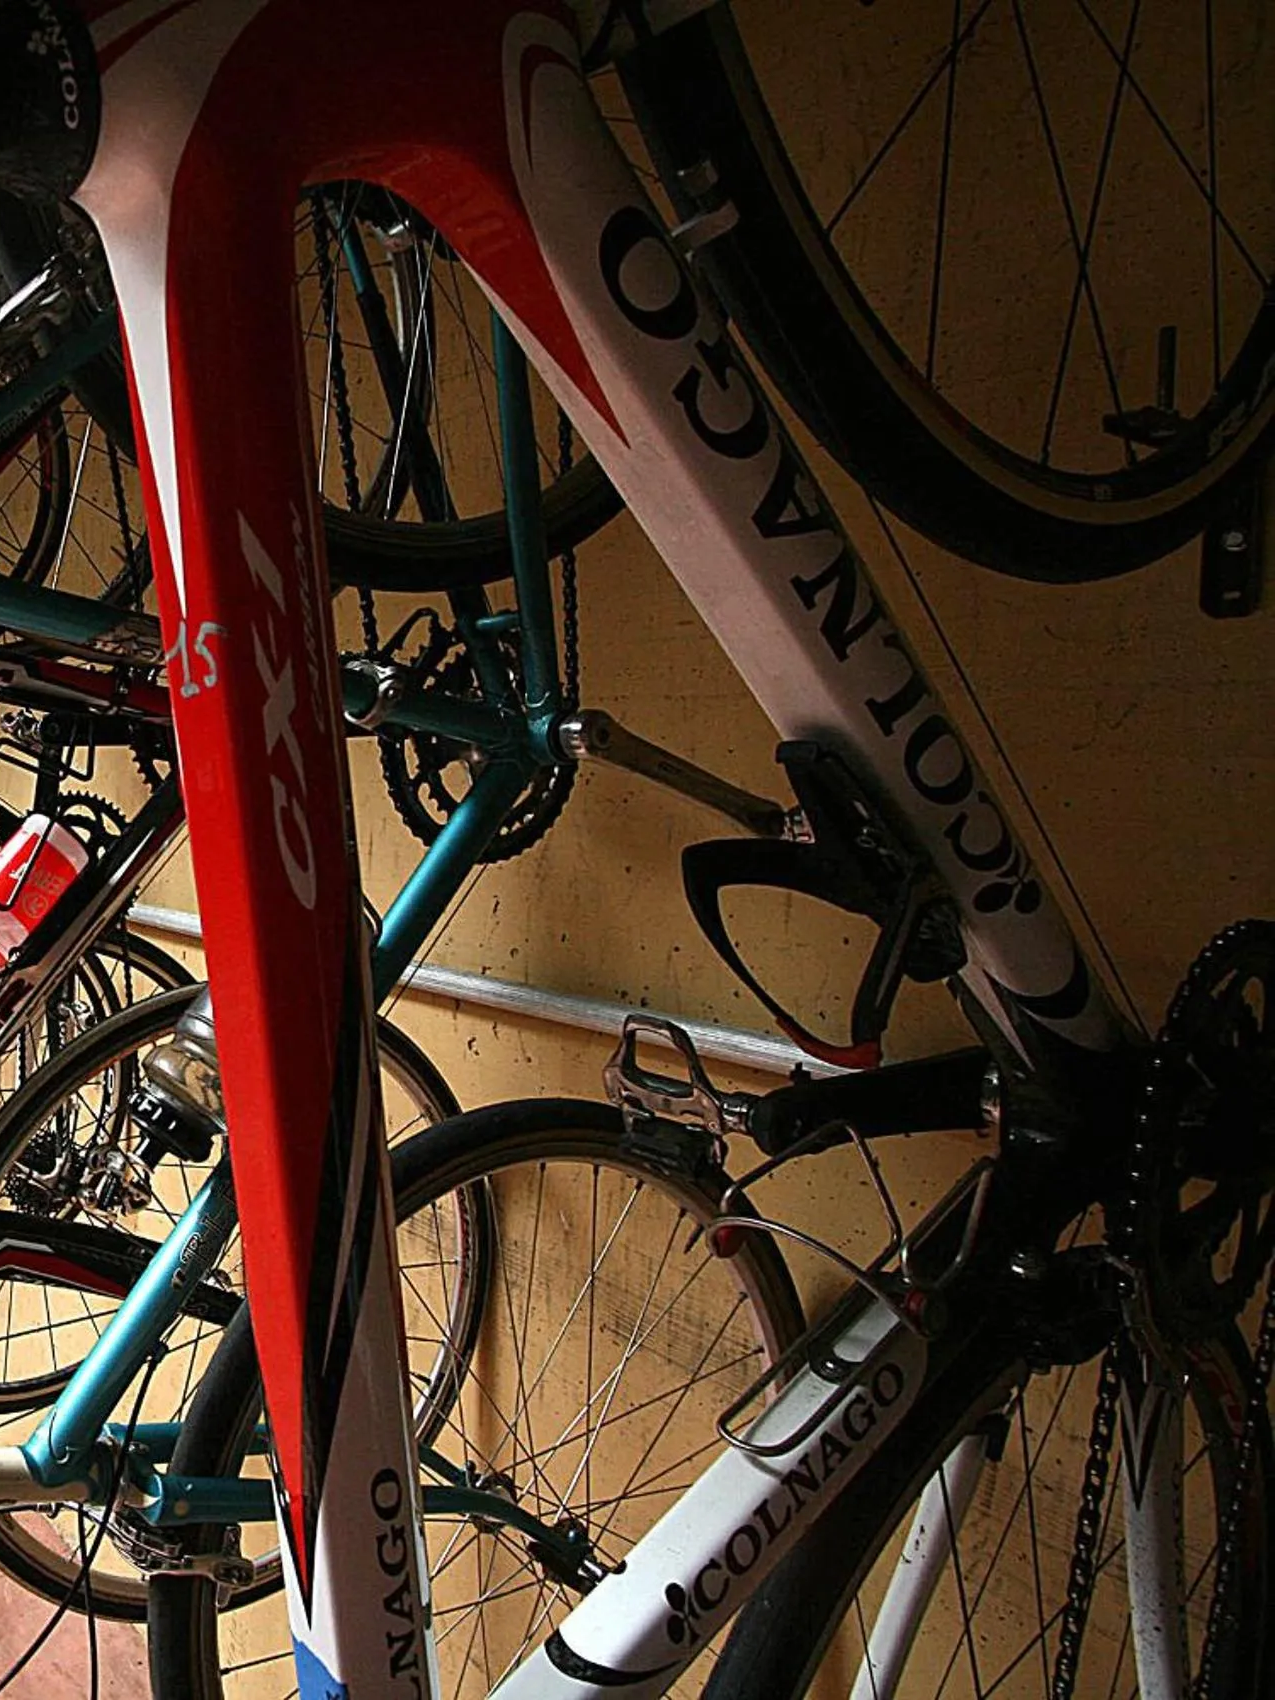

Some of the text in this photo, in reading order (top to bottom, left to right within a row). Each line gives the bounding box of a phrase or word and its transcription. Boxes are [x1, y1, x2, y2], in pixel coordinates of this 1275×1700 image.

[165, 621, 227, 698] 15
[598, 204, 1028, 873] COLNAGO
[237, 508, 316, 910] CX-1
[691, 1361, 905, 1611] COLNAGO
